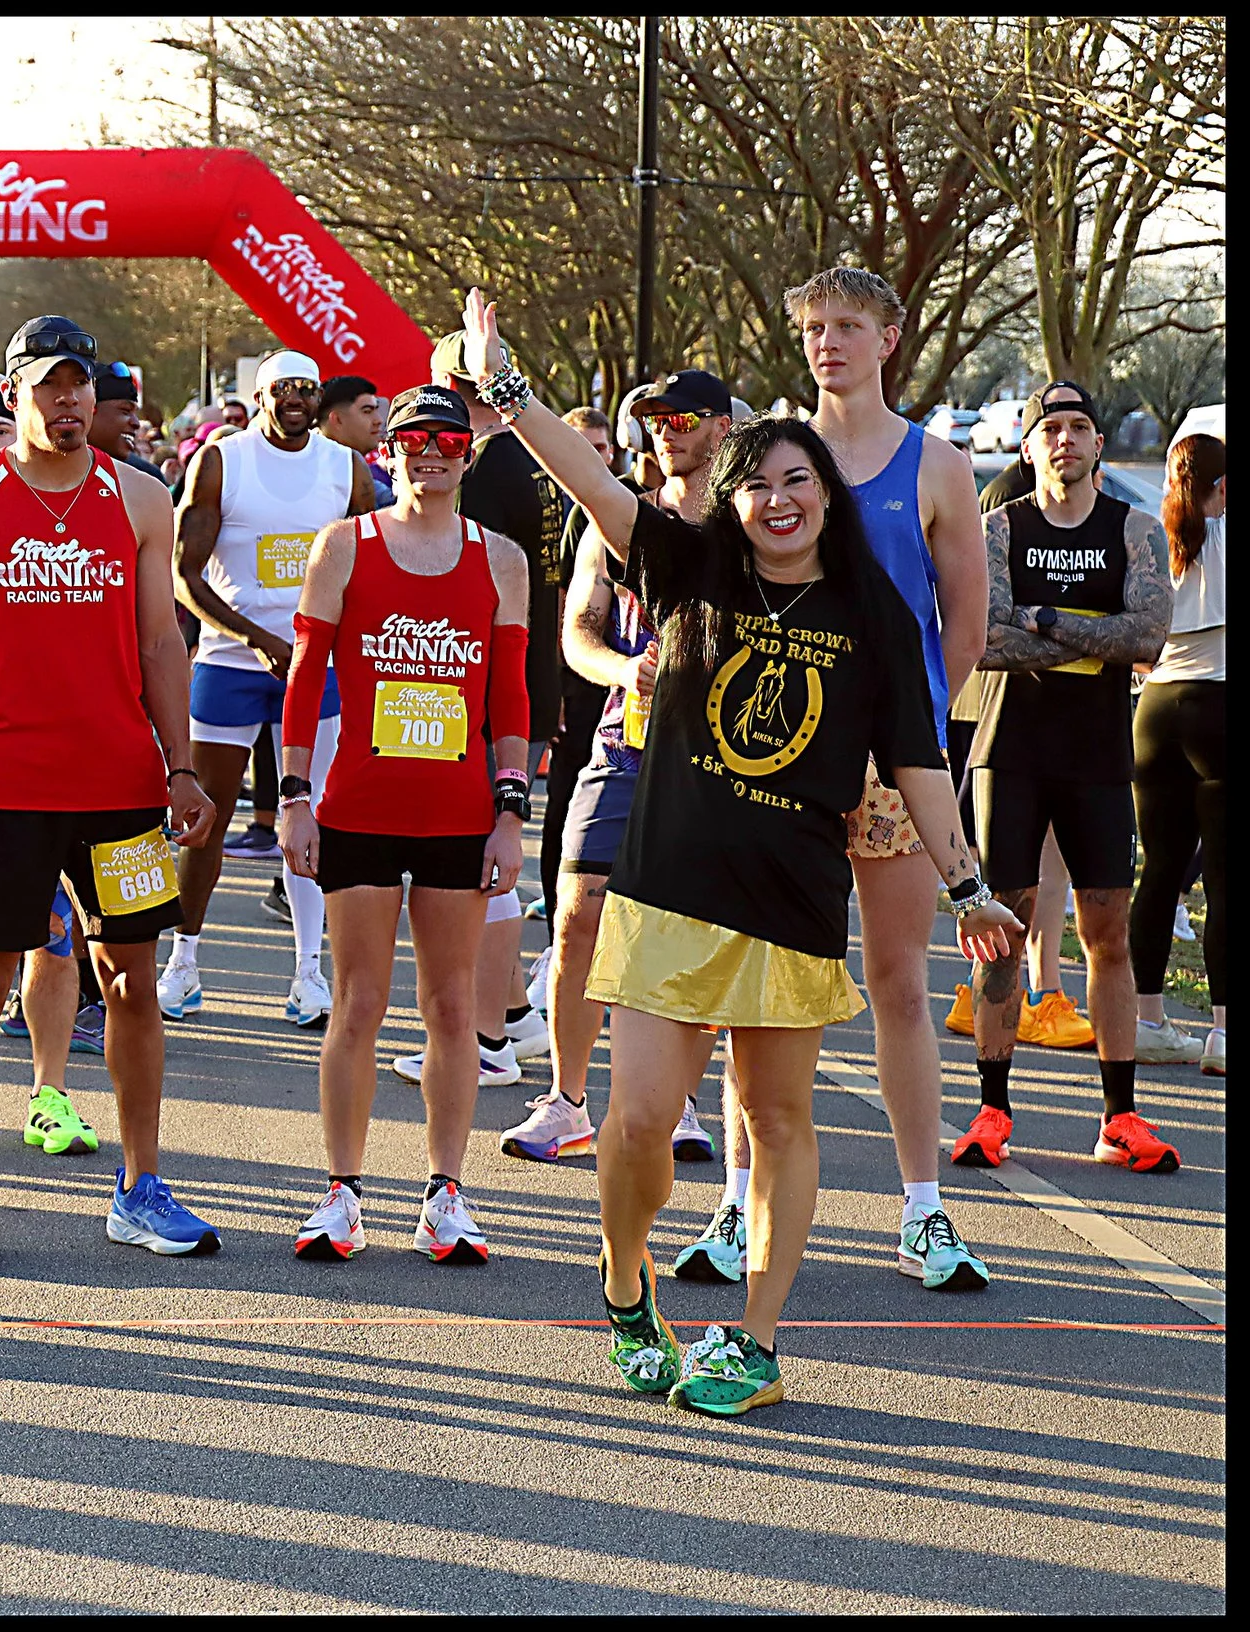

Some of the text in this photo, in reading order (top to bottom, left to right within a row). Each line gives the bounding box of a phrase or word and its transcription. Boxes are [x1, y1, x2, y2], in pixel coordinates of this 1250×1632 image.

[262, 233, 358, 321] Strictly
[232, 224, 366, 364] RUNNING
[10, 536, 106, 568] Strictly
[1026, 547, 1107, 571] GYMSHARK
[1063, 573, 1085, 583] CLUB
[6, 590, 104, 604] RACING TEAM
[382, 612, 471, 645] Strictly
[733, 611, 854, 654] RIPLE CROWN
[361, 633, 483, 664] RUNNING
[734, 624, 837, 669] ROAD RACE
[374, 660, 466, 678] RACING TEAM
[383, 701, 462, 719] RUNNING
[397, 687, 452, 706] Strictly
[399, 719, 445, 746] 700
[751, 731, 784, 748] AIKEN, SC
[702, 754, 791, 809] 5K 0 MILE
[111, 840, 158, 864] Strictly
[119, 866, 166, 902] 698
